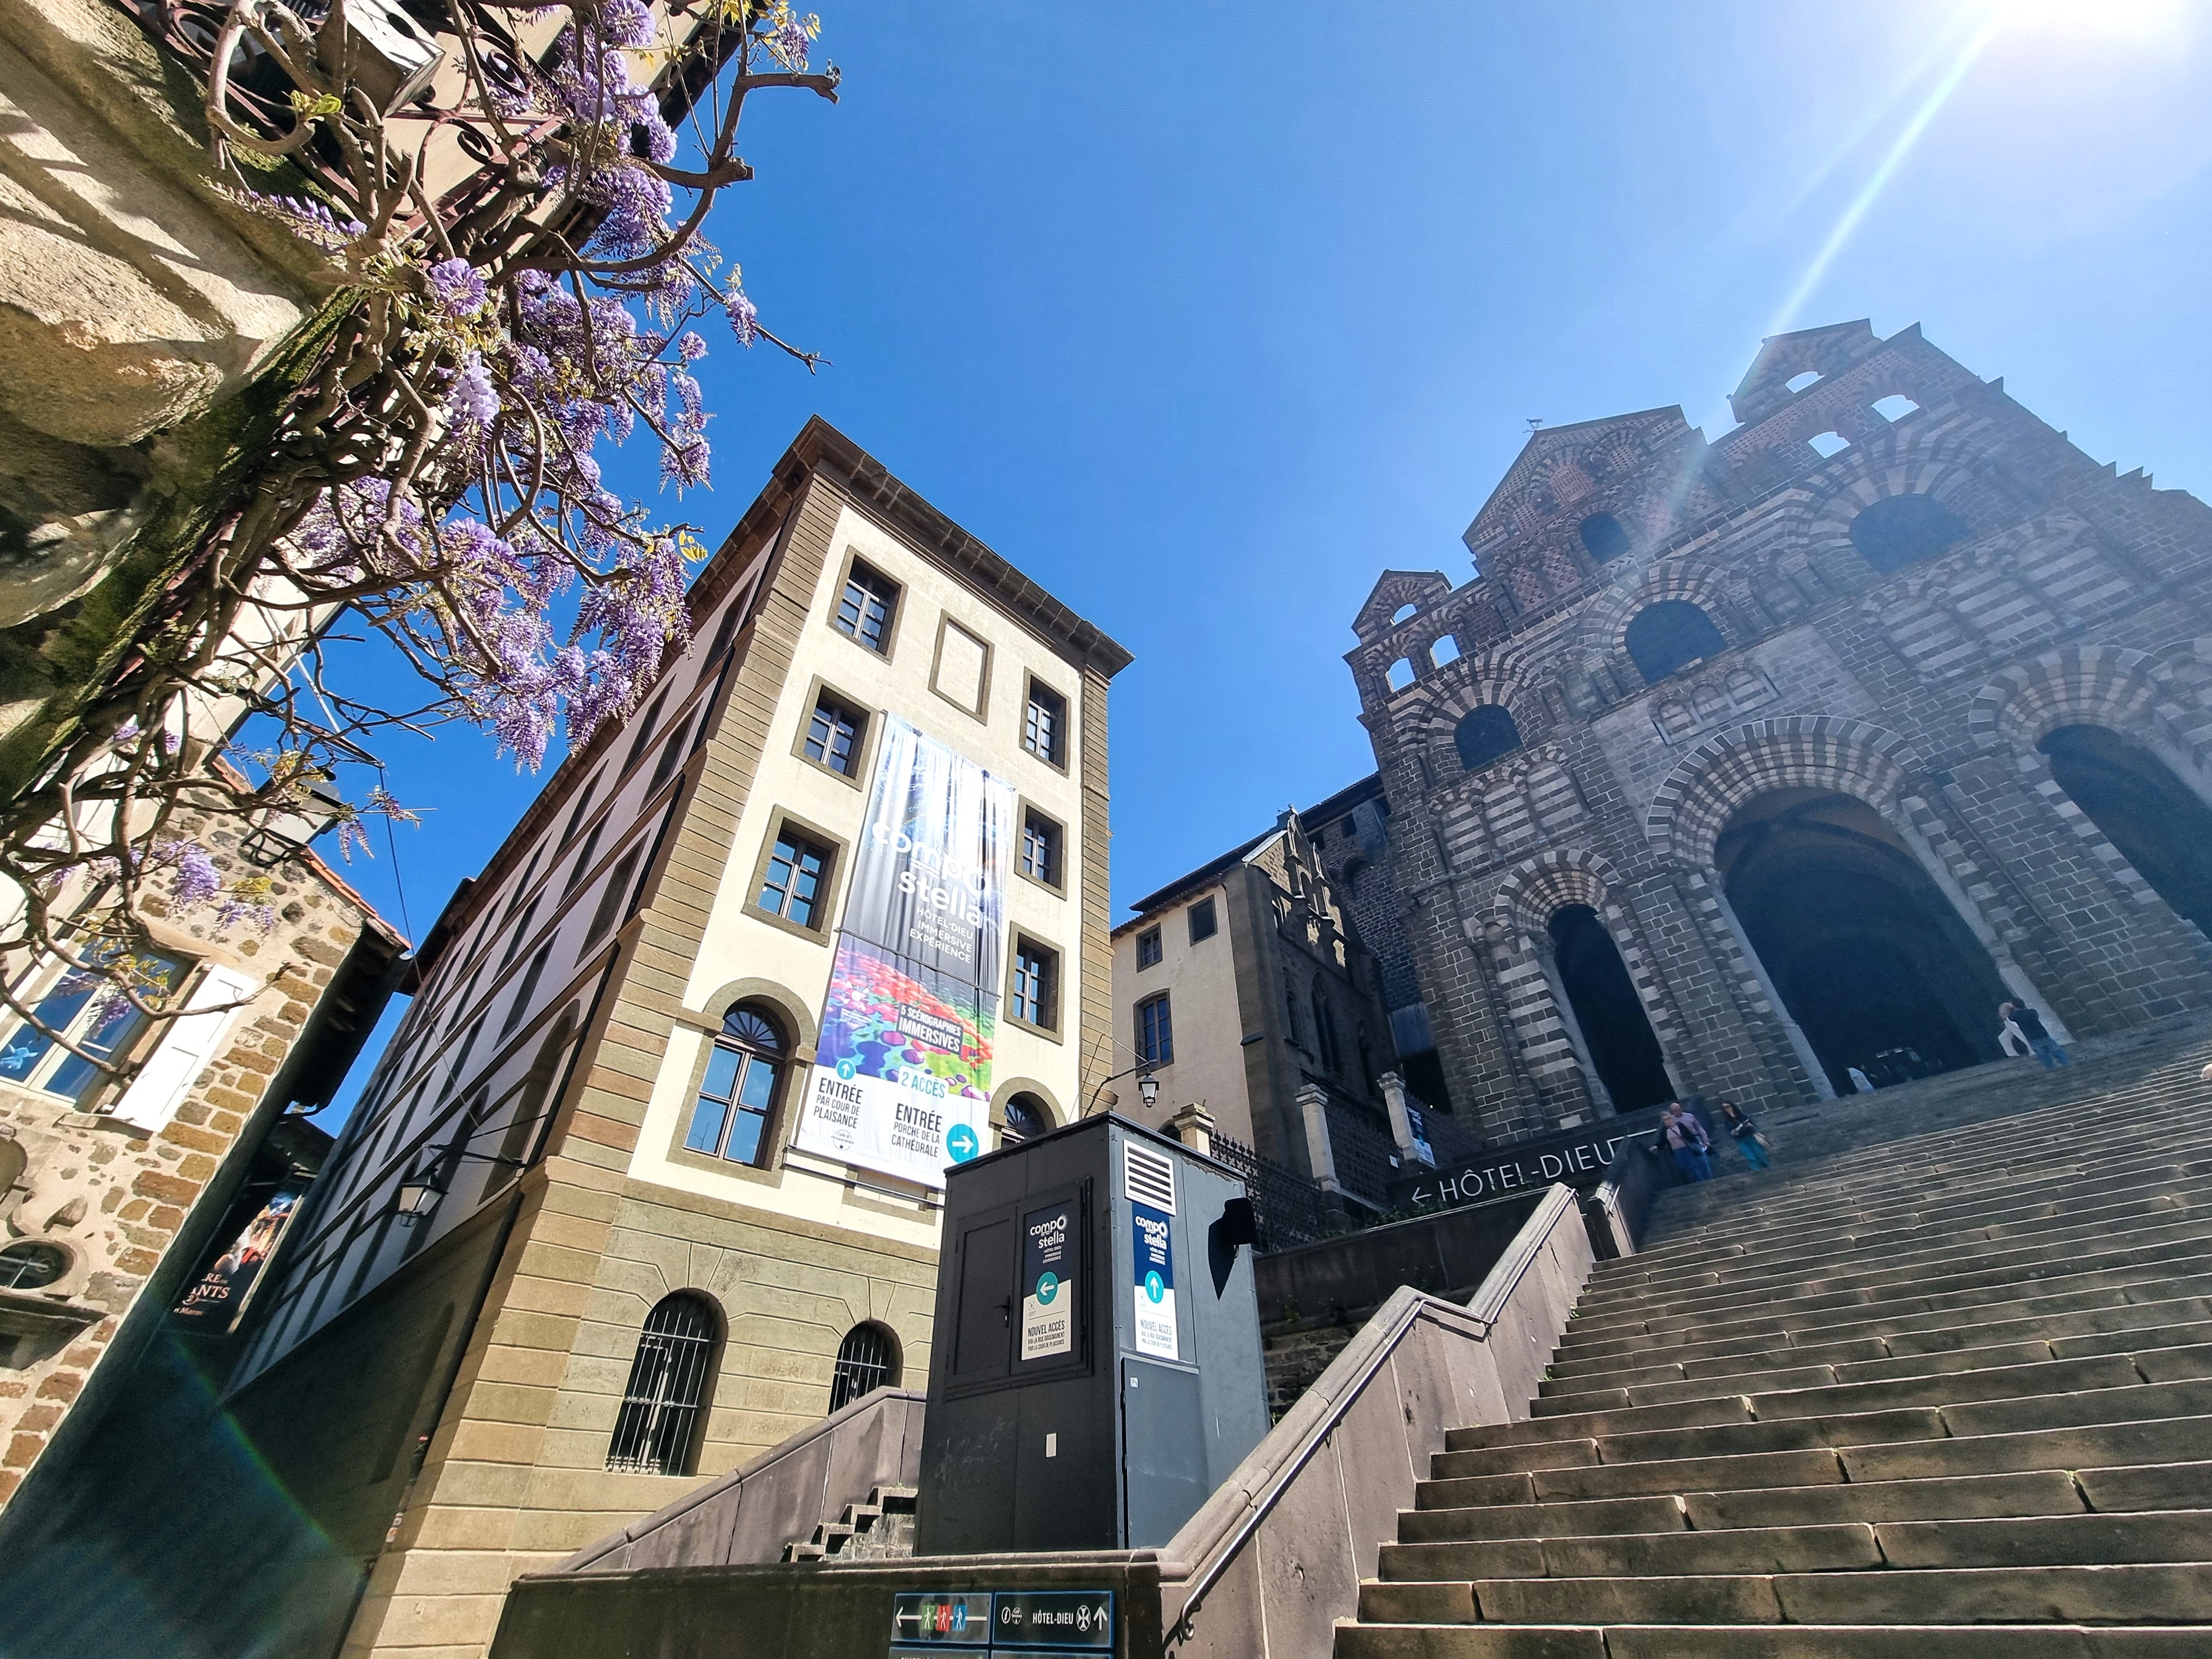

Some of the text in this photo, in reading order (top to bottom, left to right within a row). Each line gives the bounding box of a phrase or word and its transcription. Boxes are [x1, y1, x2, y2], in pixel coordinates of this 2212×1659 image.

[898, 871, 983, 928] stella
[917, 906, 973, 939] HÔTEL-DIEU
[910, 928, 972, 964] EXPÉRIENCE
[918, 920, 972, 953] IMMERSIVE
[901, 1005, 961, 1036] 5 SCÉNOGRAPHIES
[899, 1016, 960, 1052] IMMERSIVES
[818, 1077, 863, 1104] ENTRÉE
[901, 1072, 946, 1098] 2 ACCÈS
[813, 1105, 858, 1129] PLAISANCE
[816, 1094, 860, 1116] PAR COUR DE
[895, 1103, 942, 1133] ENTRÉE
[894, 1121, 940, 1144] PORCHE DE LA
[891, 1134, 939, 1158] CATHÉDRALE
[1439, 1140, 1615, 1202] HÔTEL-DIEU
[1038, 1230, 1065, 1249] stella
[1144, 1234, 1167, 1250] stella
[201, 1273, 222, 1283] RE
[1028, 1319, 1065, 1337] NOUVEL ACCÈS
[1140, 1319, 1157, 1332] NOUVEL
[1032, 1609, 1073, 1625] HÔTEL-DIEU
